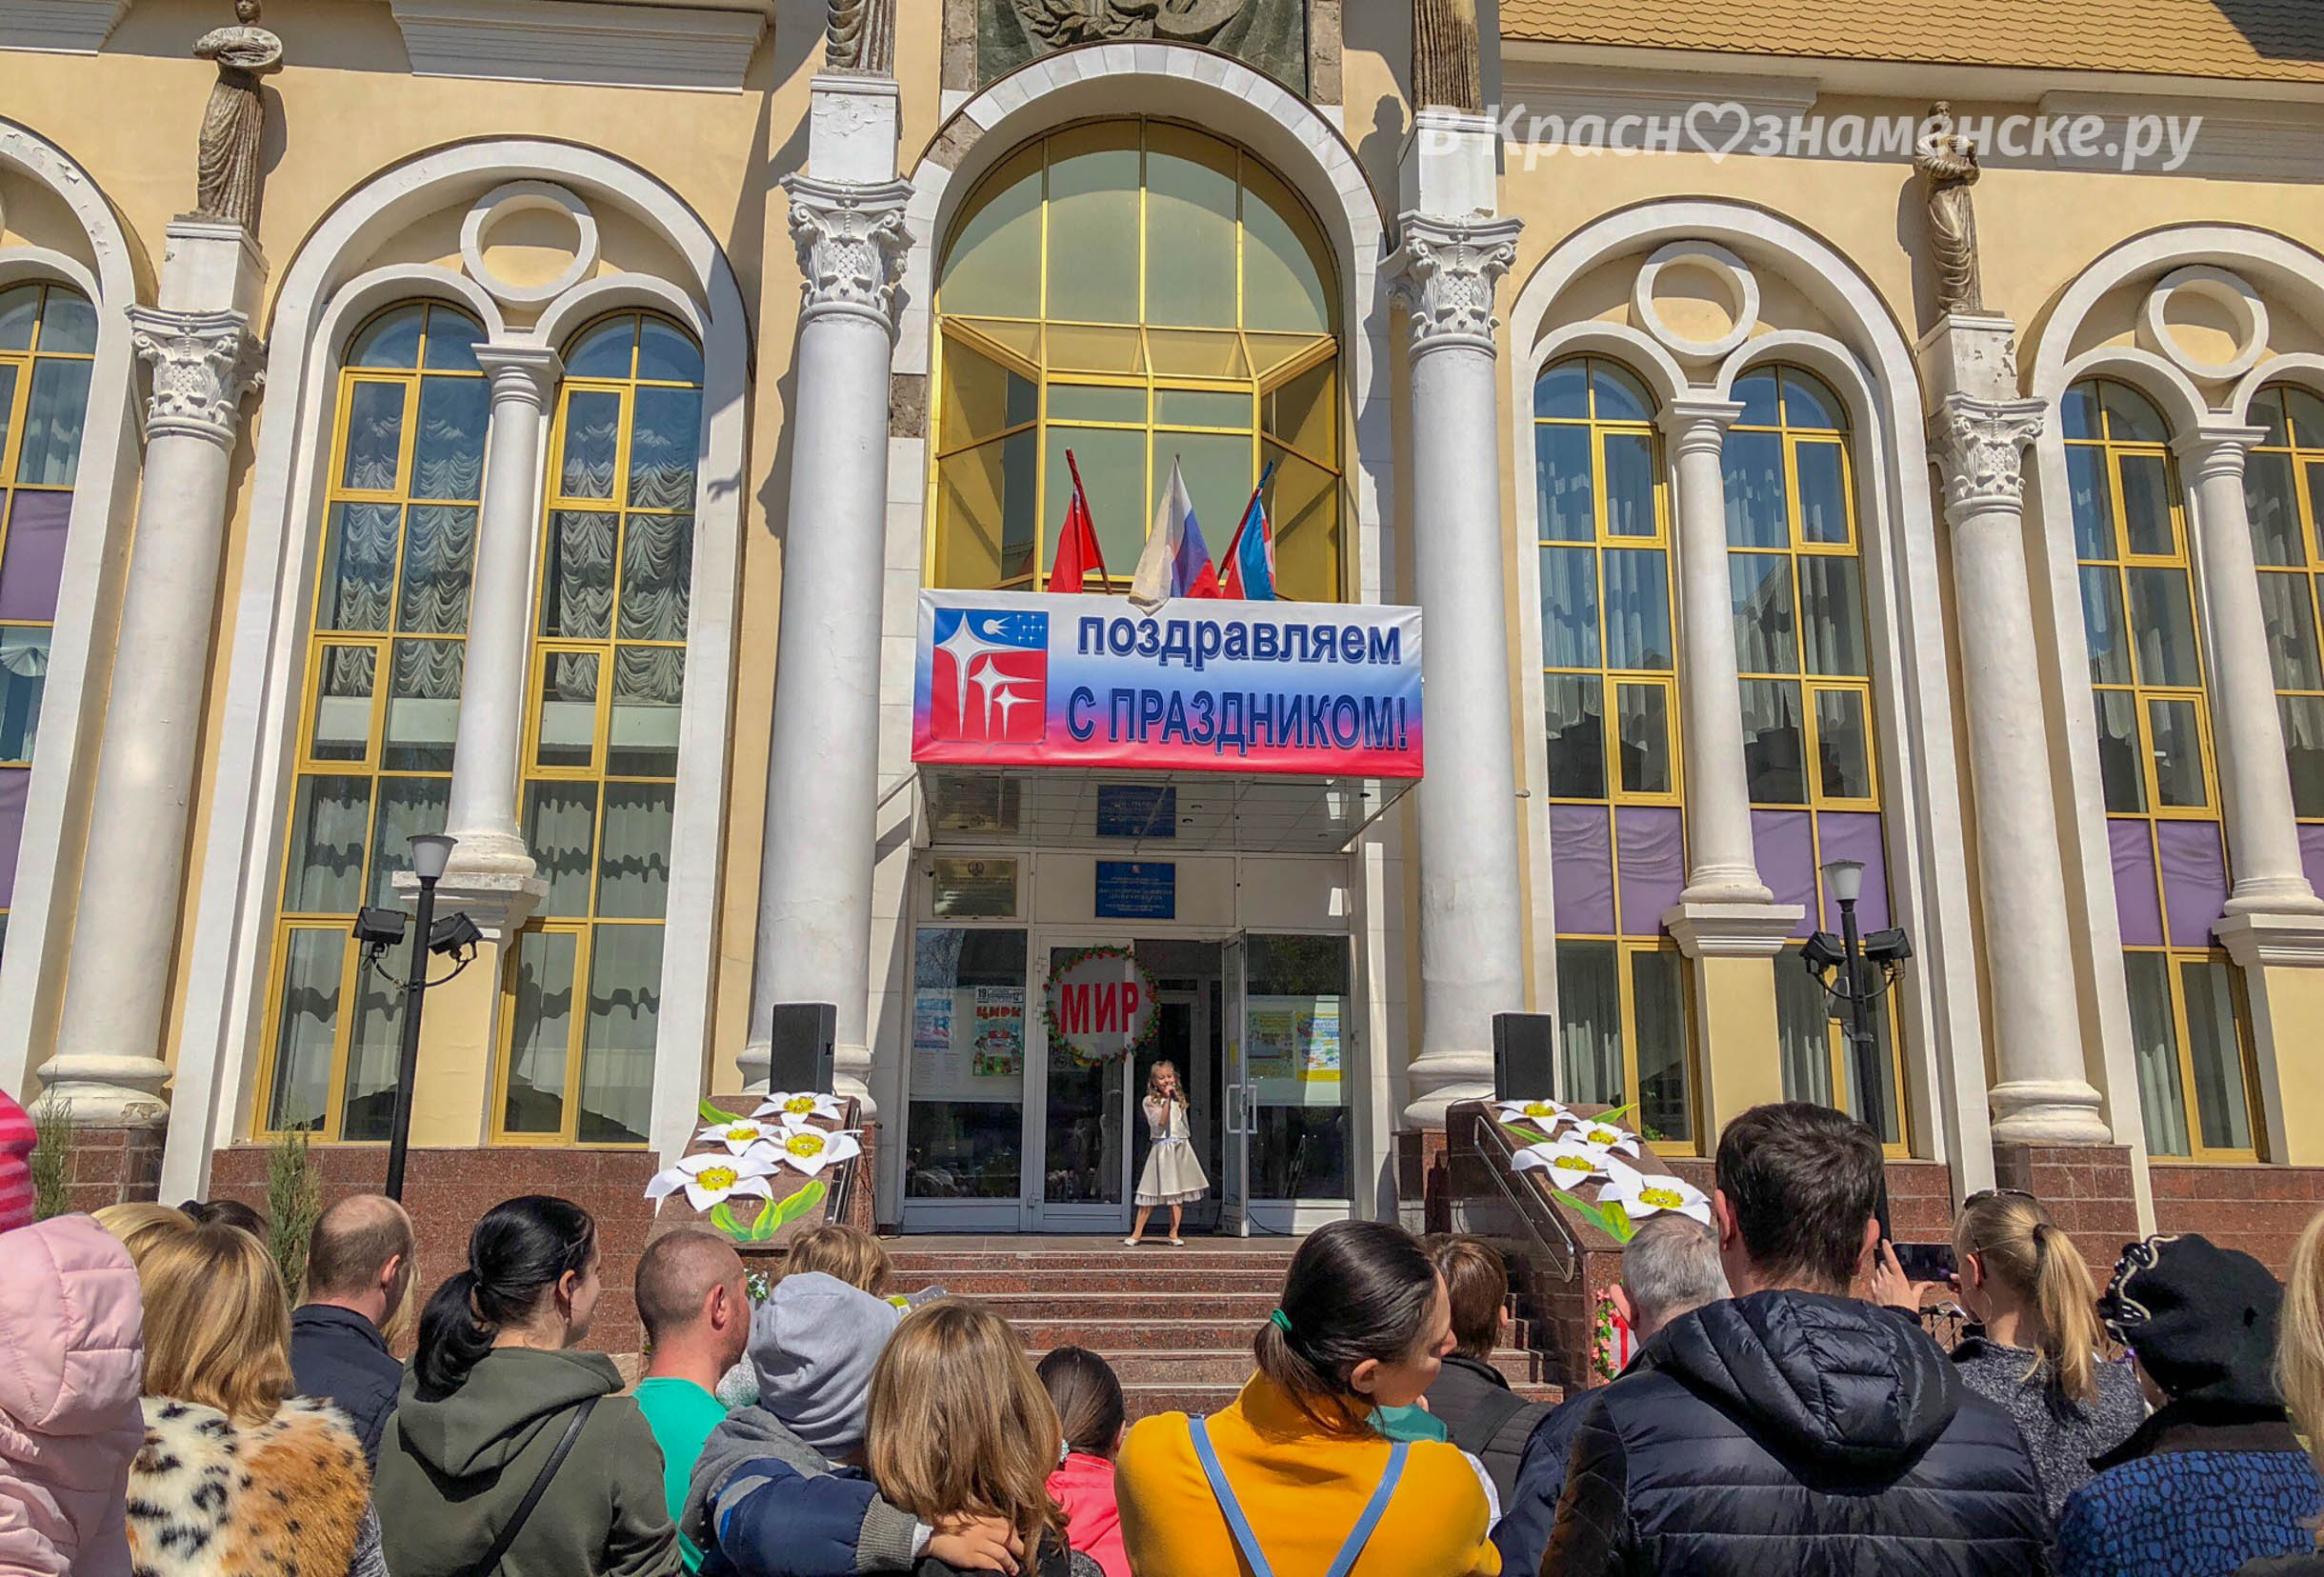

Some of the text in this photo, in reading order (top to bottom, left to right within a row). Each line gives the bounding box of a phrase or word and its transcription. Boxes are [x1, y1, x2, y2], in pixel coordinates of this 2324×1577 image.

[1077, 615, 1402, 670] поздравляем
[1066, 686, 1409, 756] С ПРАЗДНИКОМ!
[976, 1006, 1022, 1020] ЦИРК
[1060, 982, 1140, 1035] МИР
